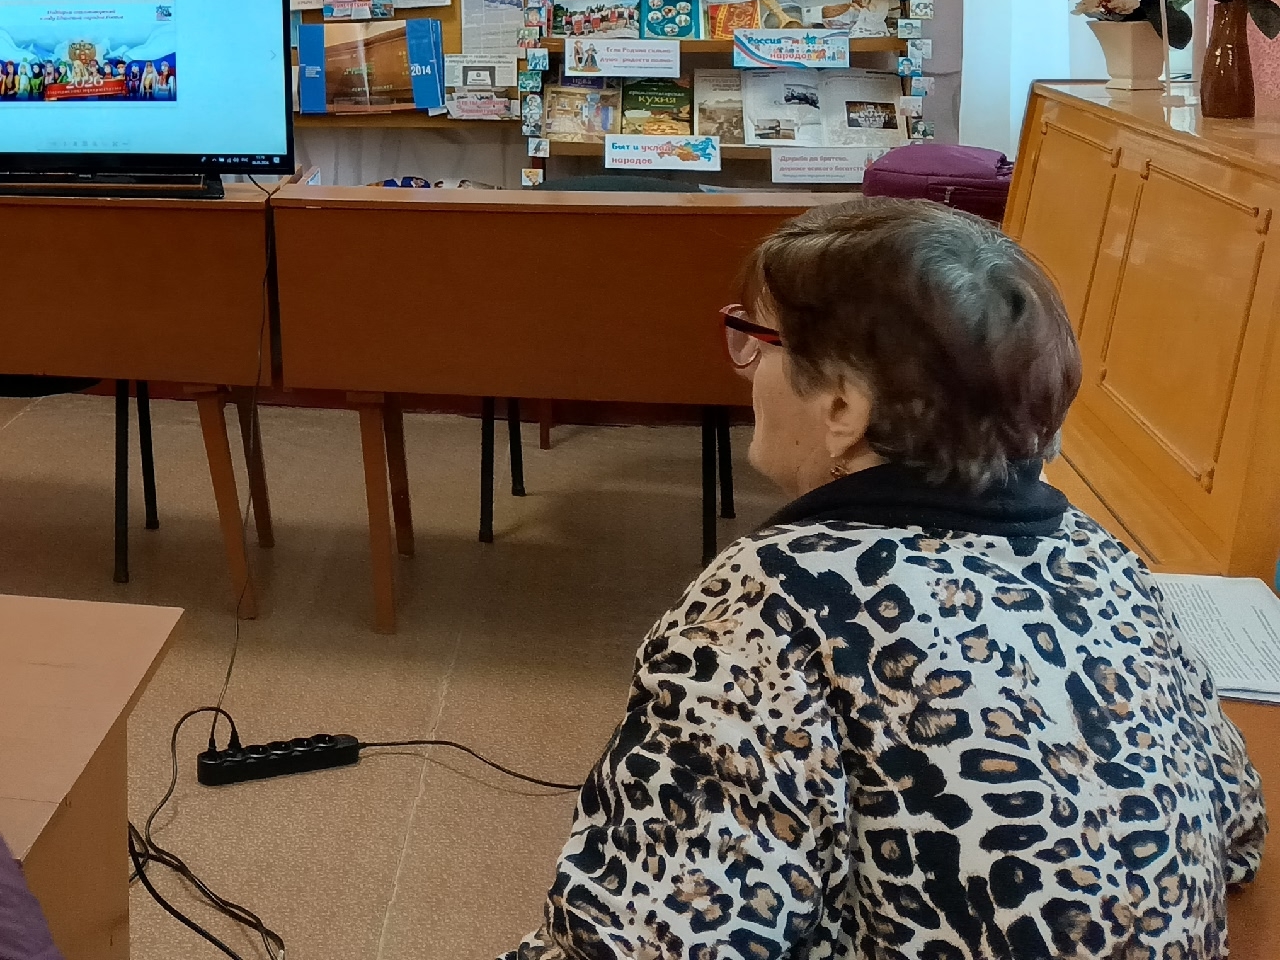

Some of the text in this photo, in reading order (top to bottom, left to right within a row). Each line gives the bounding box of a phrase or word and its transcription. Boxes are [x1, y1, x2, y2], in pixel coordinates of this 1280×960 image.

[747, 36, 782, 45] Россия
[770, 52, 813, 61] народов
[411, 65, 431, 76] 2014
[611, 142, 631, 150] Быт
[611, 157, 653, 165] народов
